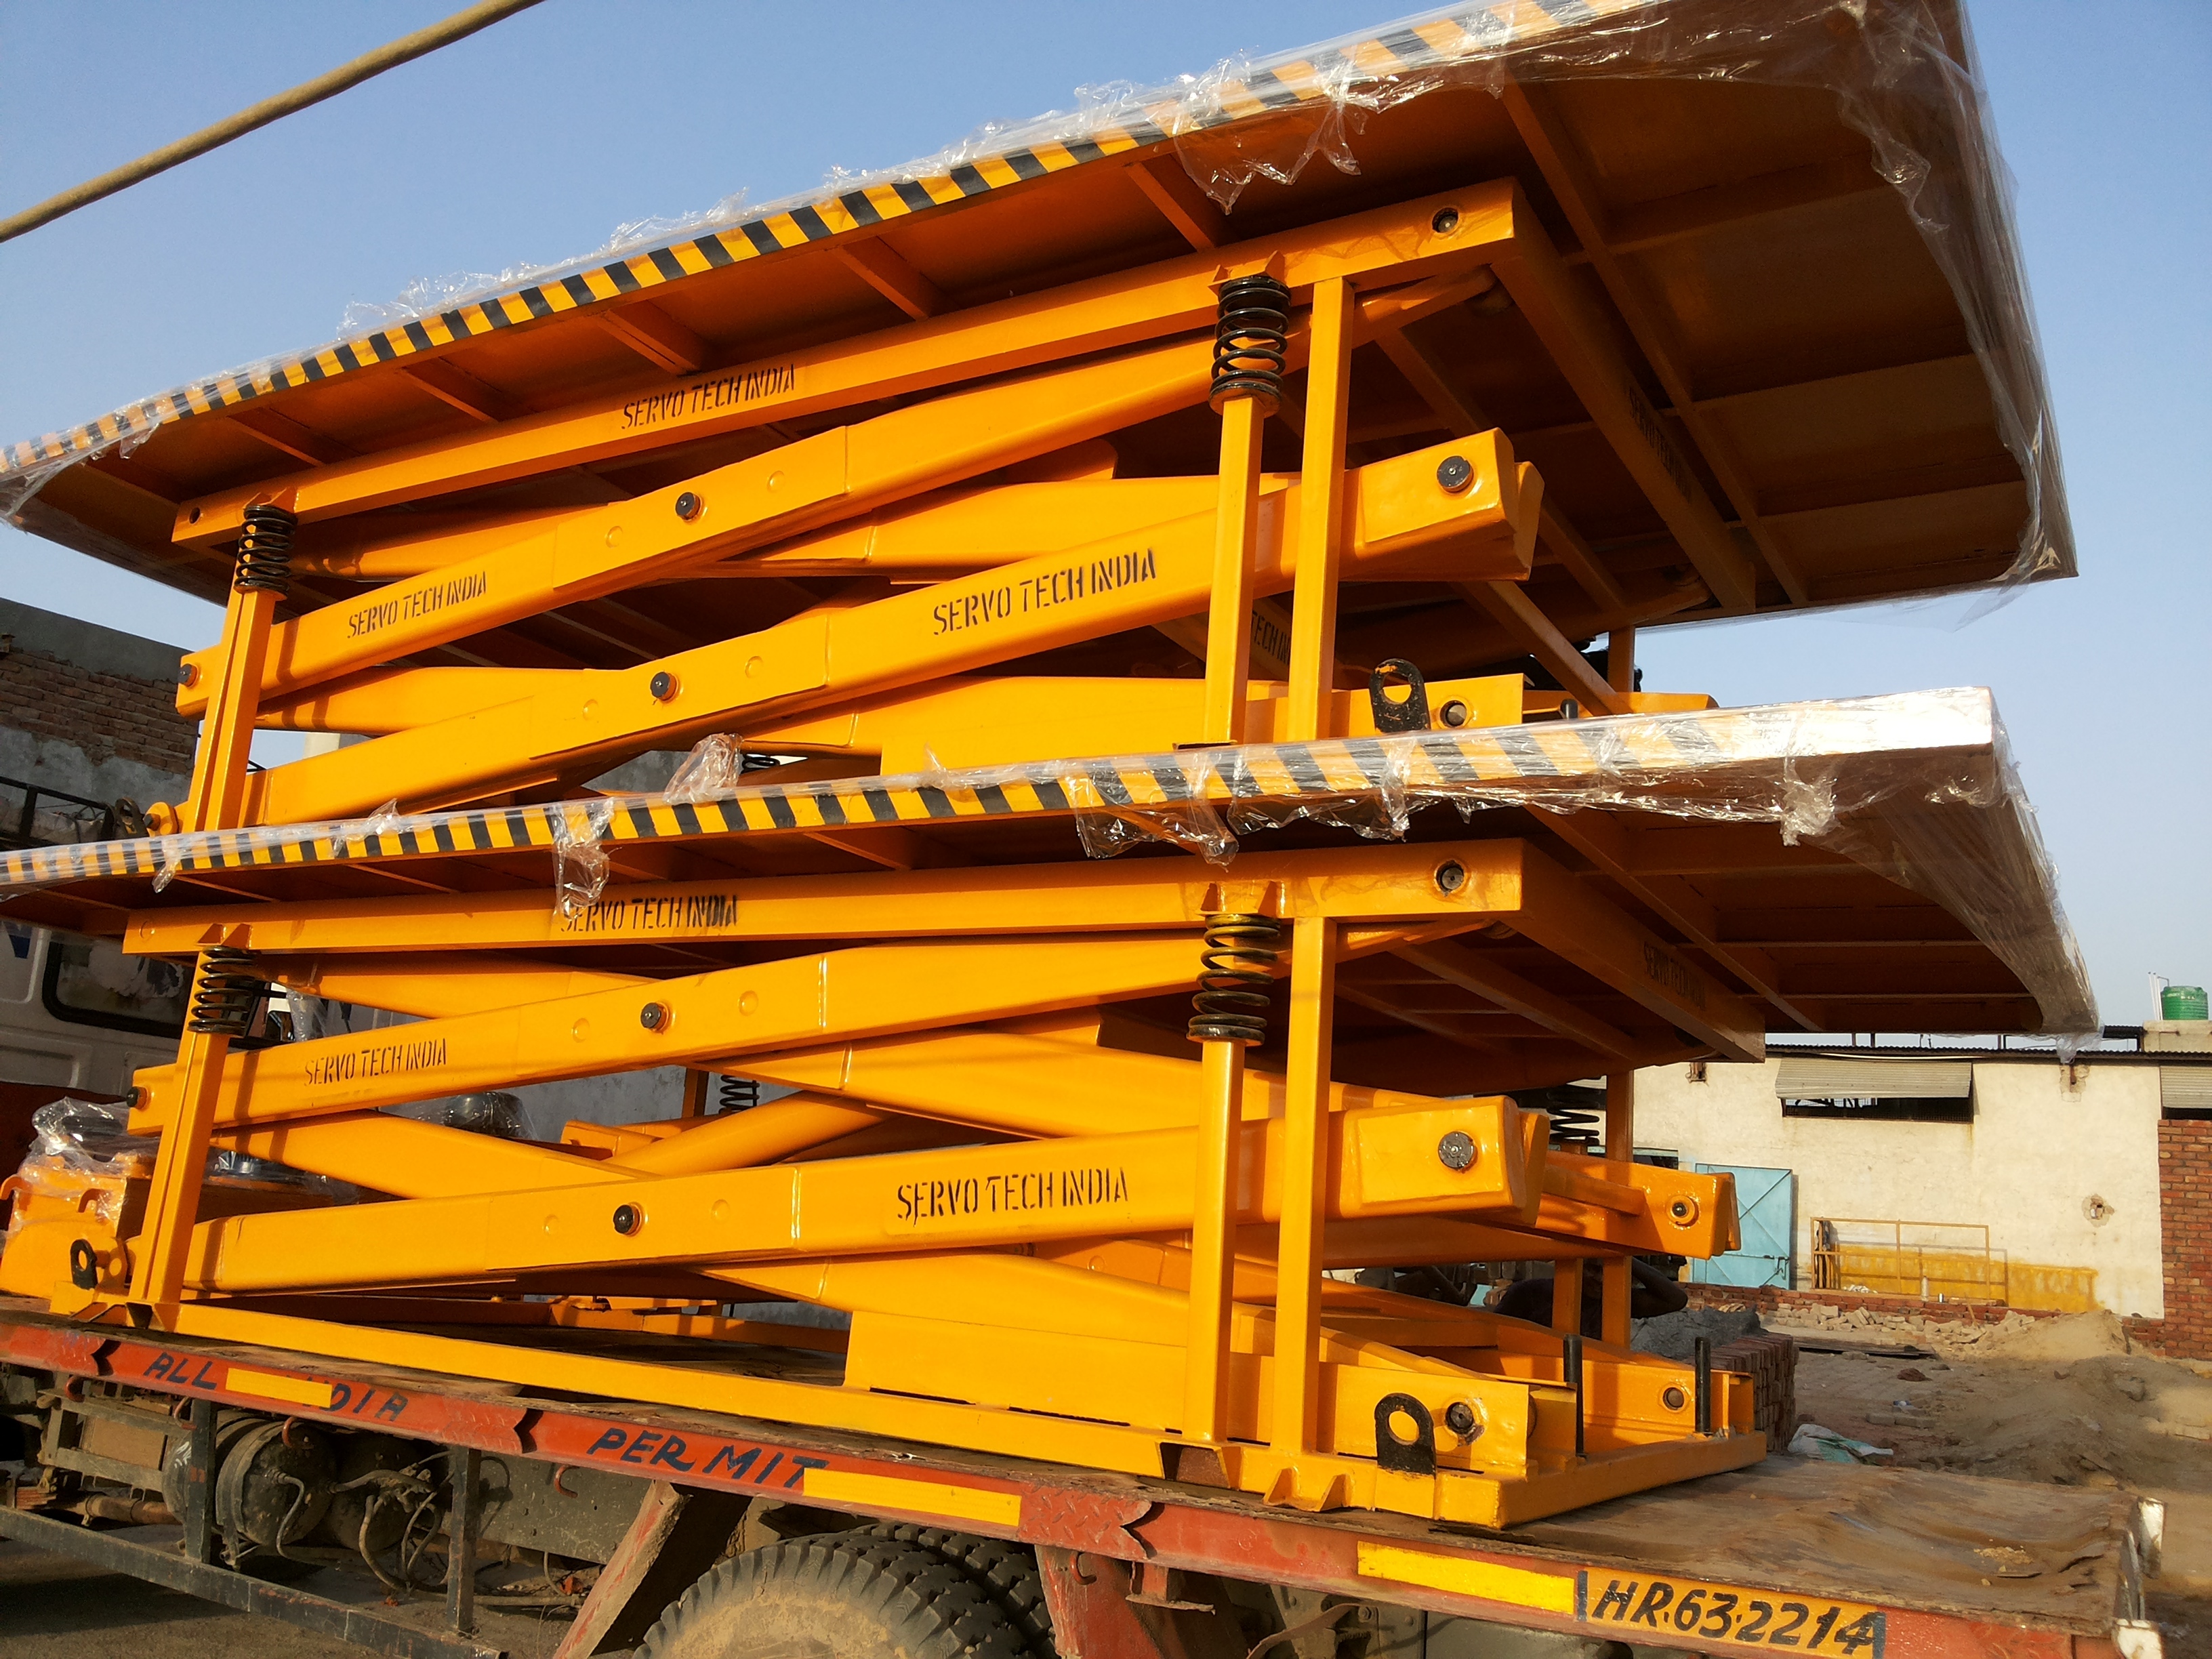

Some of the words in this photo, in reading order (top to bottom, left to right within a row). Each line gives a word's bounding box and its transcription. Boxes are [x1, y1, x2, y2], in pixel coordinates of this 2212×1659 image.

[621, 390, 685, 430] SERVO
[691, 375, 742, 413] TECH
[745, 363, 795, 401] INDIA
[347, 600, 398, 639] SERVO
[403, 584, 444, 620] TECH
[446, 571, 487, 607] INDIA
[933, 586, 1012, 636] SERVO
[1019, 567, 1084, 612] TECH
[1090, 548, 1157, 594] INDIA
[631, 897, 683, 930] TECH
[687, 894, 738, 928] INDIA
[304, 1052, 356, 1086] SERVO
[361, 1044, 403, 1078] TECH
[405, 1038, 447, 1071] INDIA
[897, 1178, 979, 1222] SERVO
[985, 1170, 1054, 1212] TECH
[1062, 1166, 1128, 1207] INDIA
[143, 1351, 218, 1391] ALL
